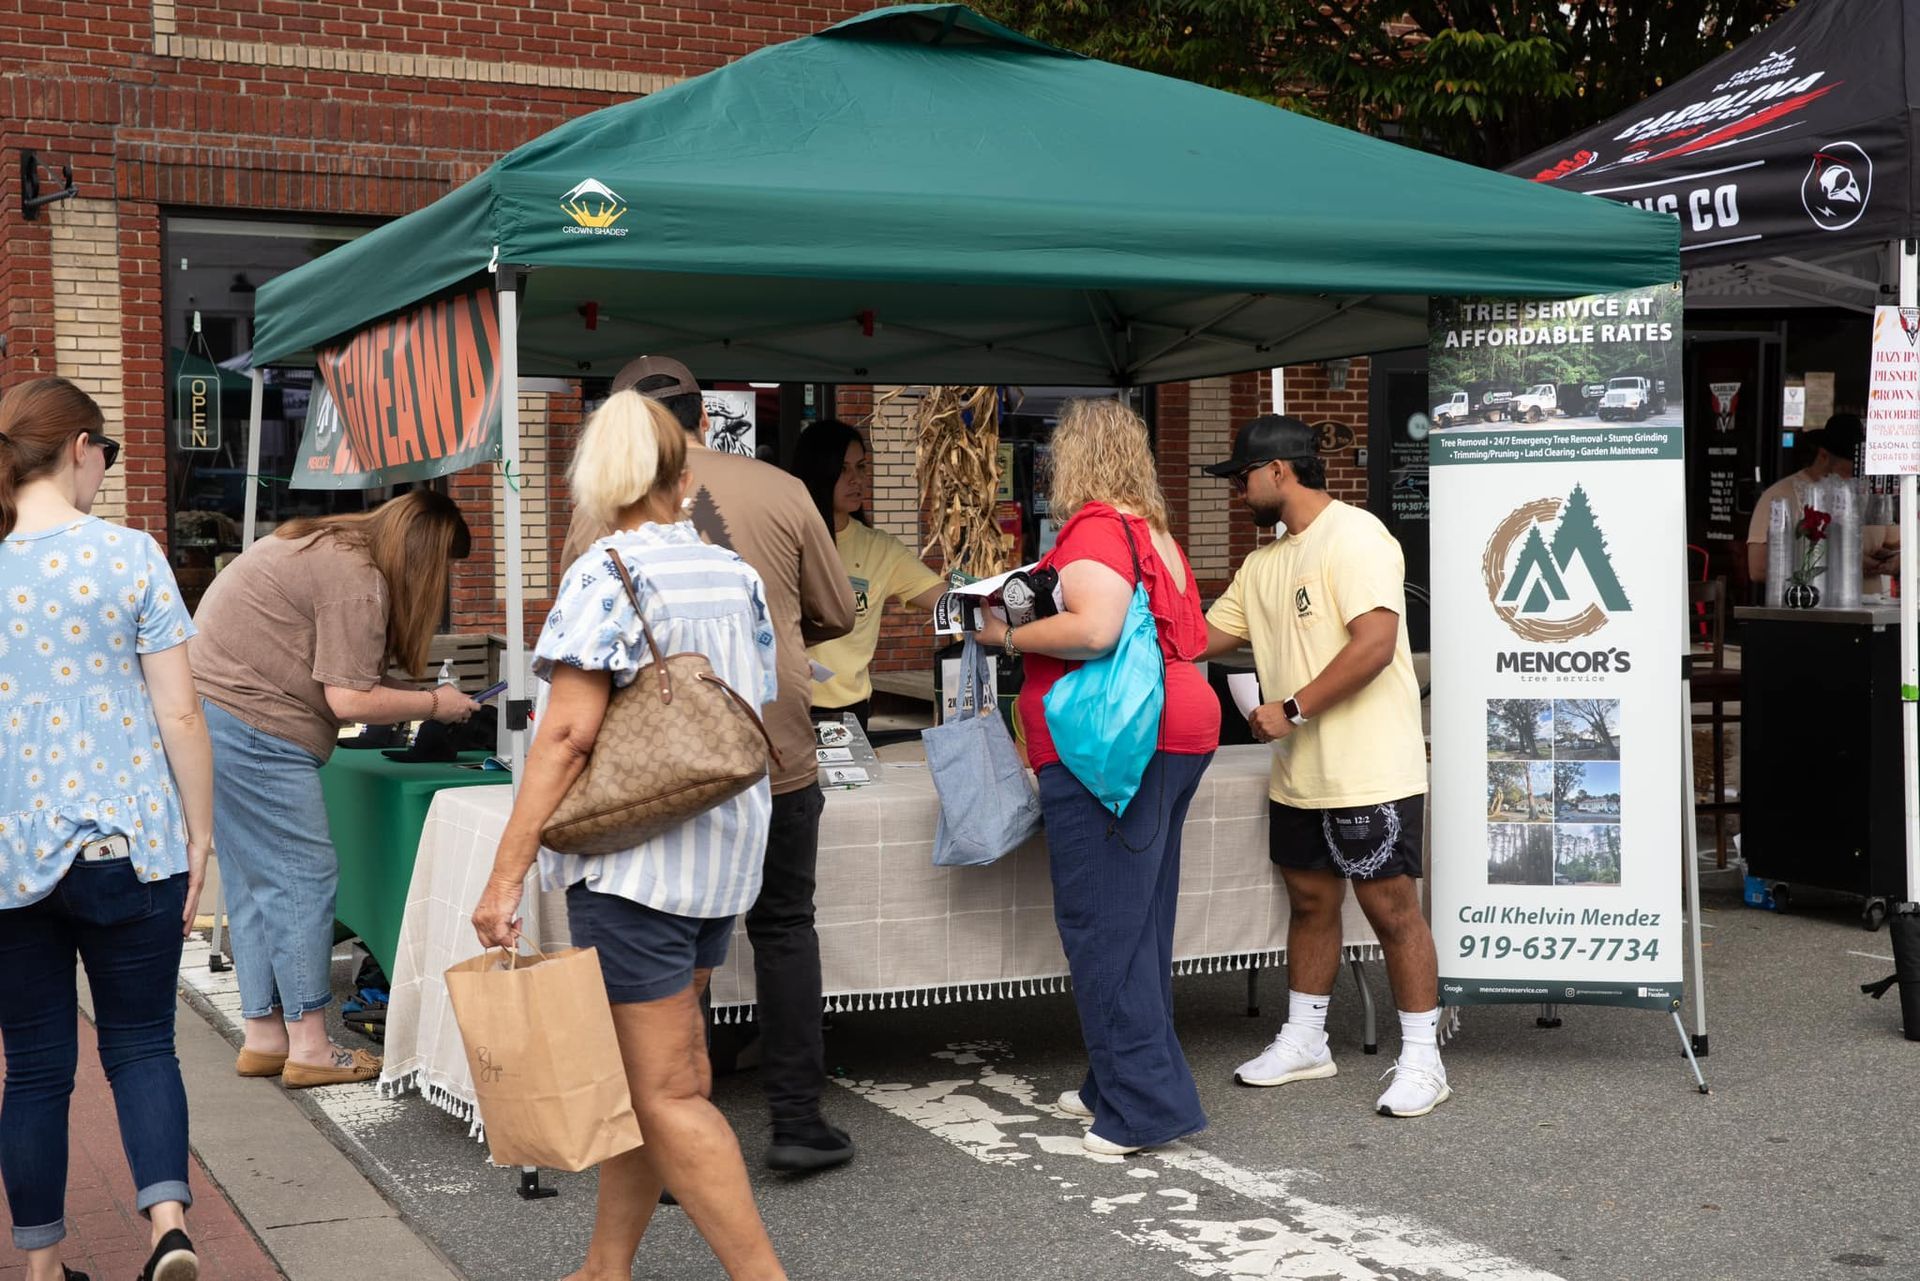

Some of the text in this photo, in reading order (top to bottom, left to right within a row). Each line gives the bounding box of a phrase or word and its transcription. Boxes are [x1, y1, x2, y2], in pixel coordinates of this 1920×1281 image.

[1613, 71, 1826, 141] CAROLINA
[1689, 184, 1740, 232] CO
[562, 226, 593, 235] CROWN
[1463, 297, 1654, 322] TREE SERVICE AT
[1445, 322, 1673, 348] AFFORDABLE RATES
[1876, 351, 1900, 362] HAZY
[1875, 370, 1917, 381] PILSNER
[1873, 389, 1914, 400] BROWN
[191, 379, 207, 447] OPEN
[1321, 423, 1337, 449] 3
[1440, 438, 1456, 448] Tree
[1457, 436, 1489, 447] Removal
[1493, 436, 1510, 446] 24/7
[1511, 436, 1553, 447] Emergency
[1553, 435, 1570, 445] Tree
[1570, 434, 1603, 444] Removal
[1608, 433, 1633, 445] Stump
[1634, 432, 1668, 444] Grinding
[1869, 441, 1909, 449] SEASONAL
[1453, 446, 1659, 461] Trimming/Pruning Land Clearing Garden Maintenance
[1496, 647, 1632, 673] MENCOR'S
[1521, 674, 1606, 683] tree service
[1459, 905, 1661, 927] Call Khelvin Mendez
[1459, 934, 1660, 962] 919-637-7734
[1444, 984, 1463, 993] Google
[1479, 986, 1549, 994] mencorstreeservice.com
